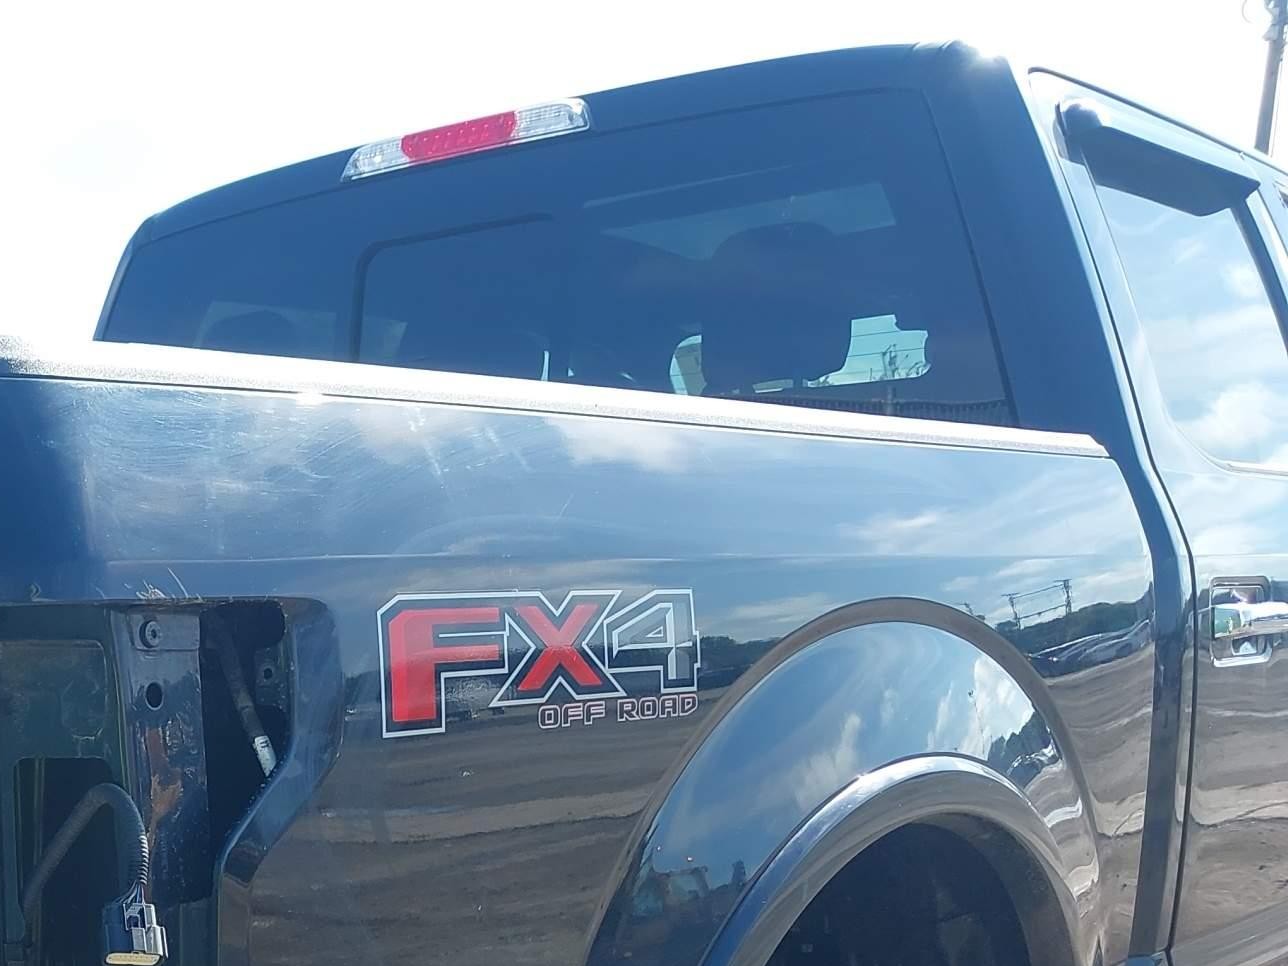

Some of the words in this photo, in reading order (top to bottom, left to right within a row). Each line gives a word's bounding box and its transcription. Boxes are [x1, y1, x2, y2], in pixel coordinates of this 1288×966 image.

[377, 588, 700, 738] FX4
[538, 701, 607, 730] OFF
[617, 694, 698, 722] ROAD
